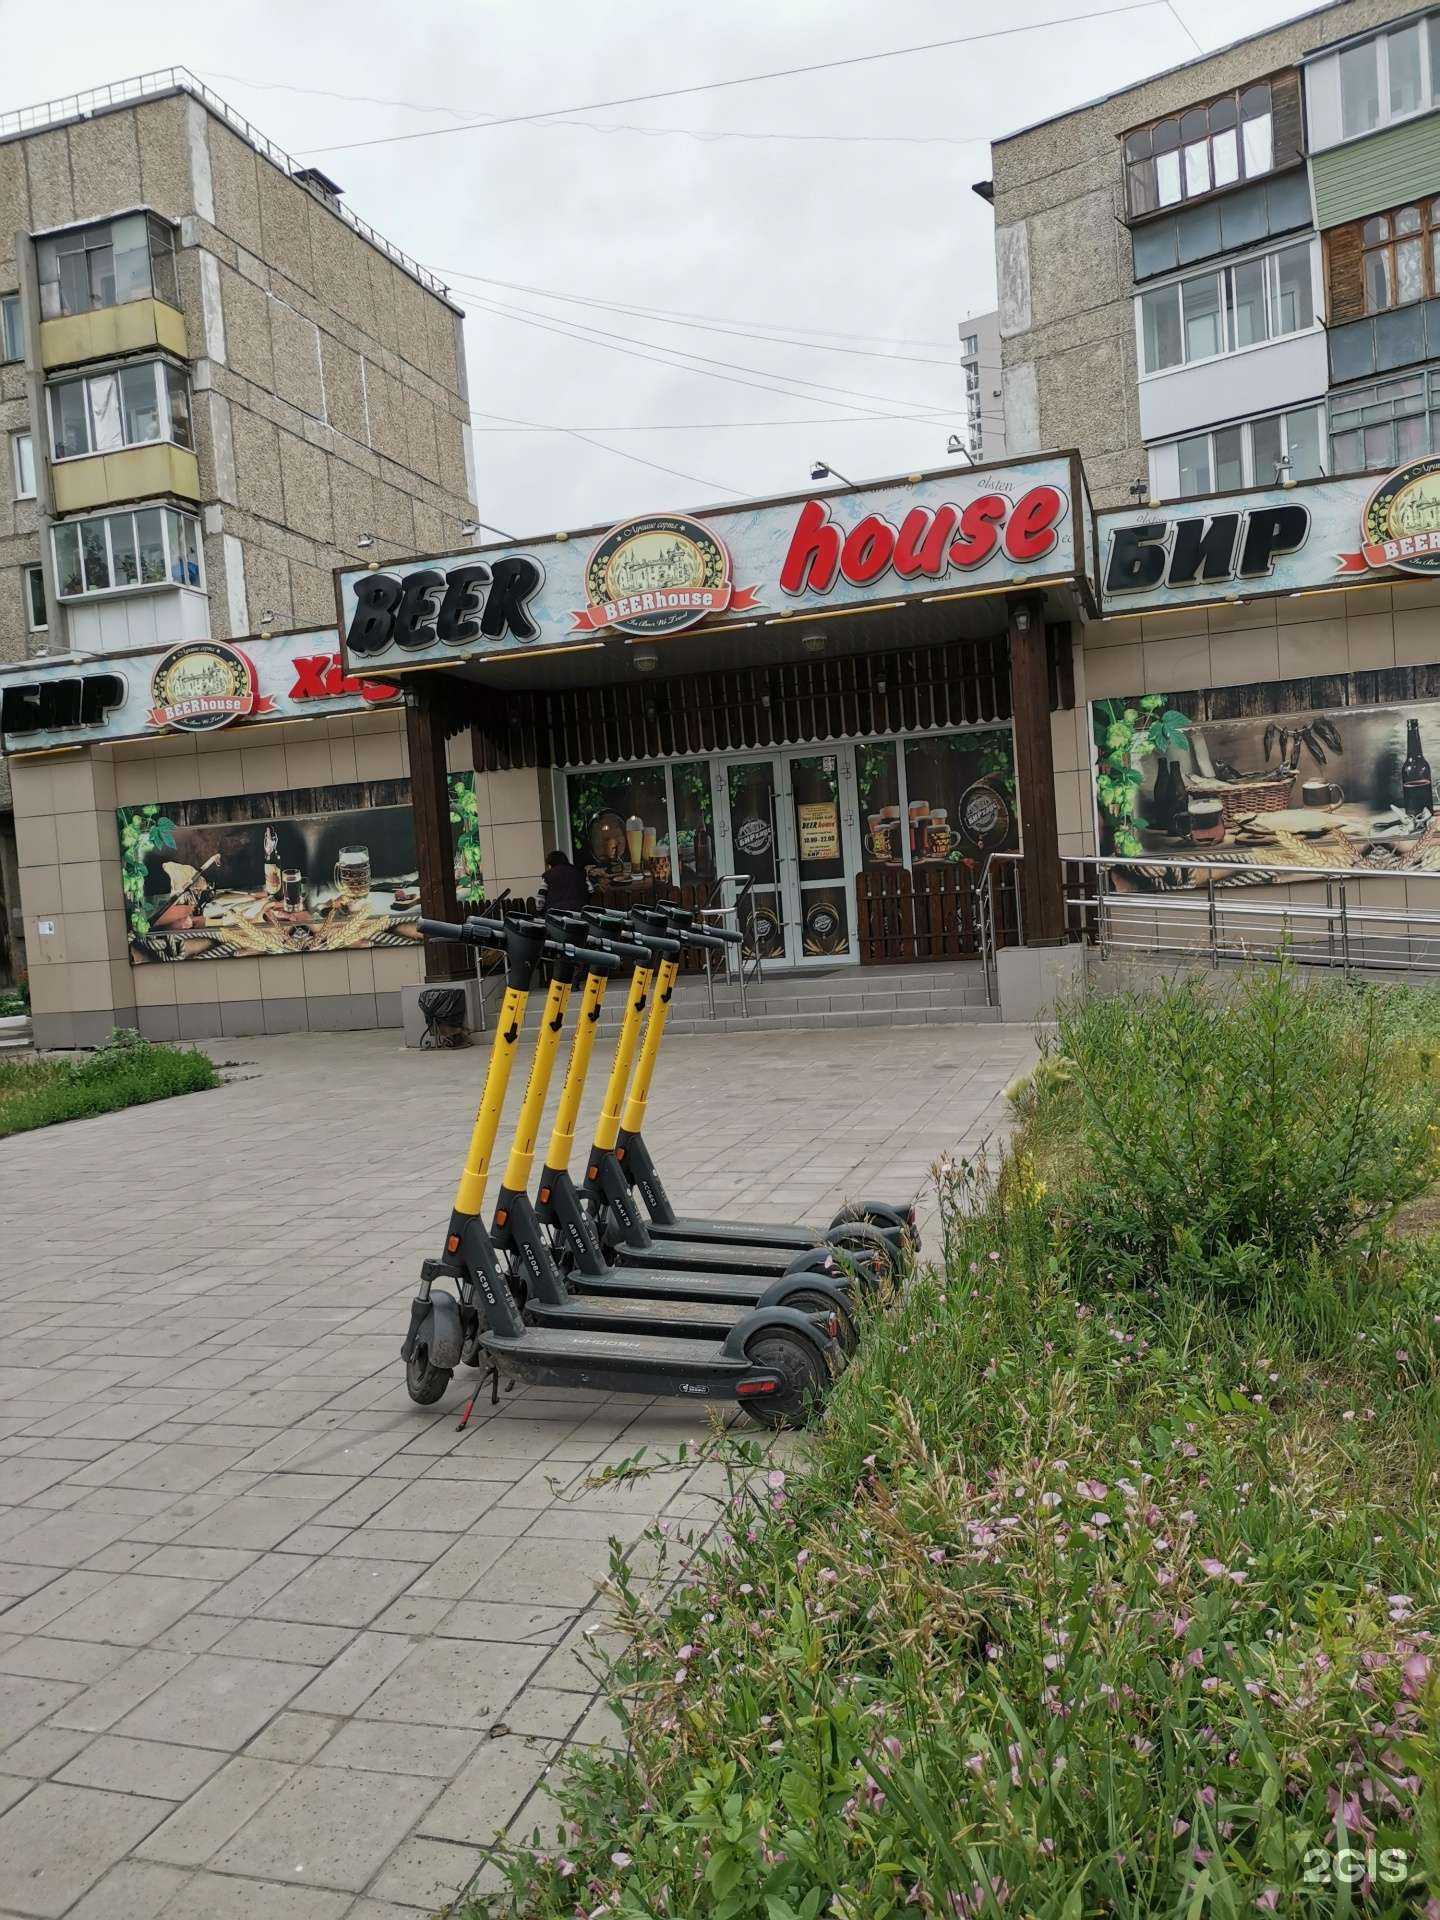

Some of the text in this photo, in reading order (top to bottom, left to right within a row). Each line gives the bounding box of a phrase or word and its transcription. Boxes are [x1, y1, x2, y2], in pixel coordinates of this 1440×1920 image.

[1103, 503, 1310, 594] БИР
[346, 485, 1068, 656] BEER house
[604, 590, 713, 622] BEERhouse
[165, 699, 241, 720] BEERhouse
[523, 1244, 541, 1277] AC2084
[476, 1270, 496, 1304] AC9109
